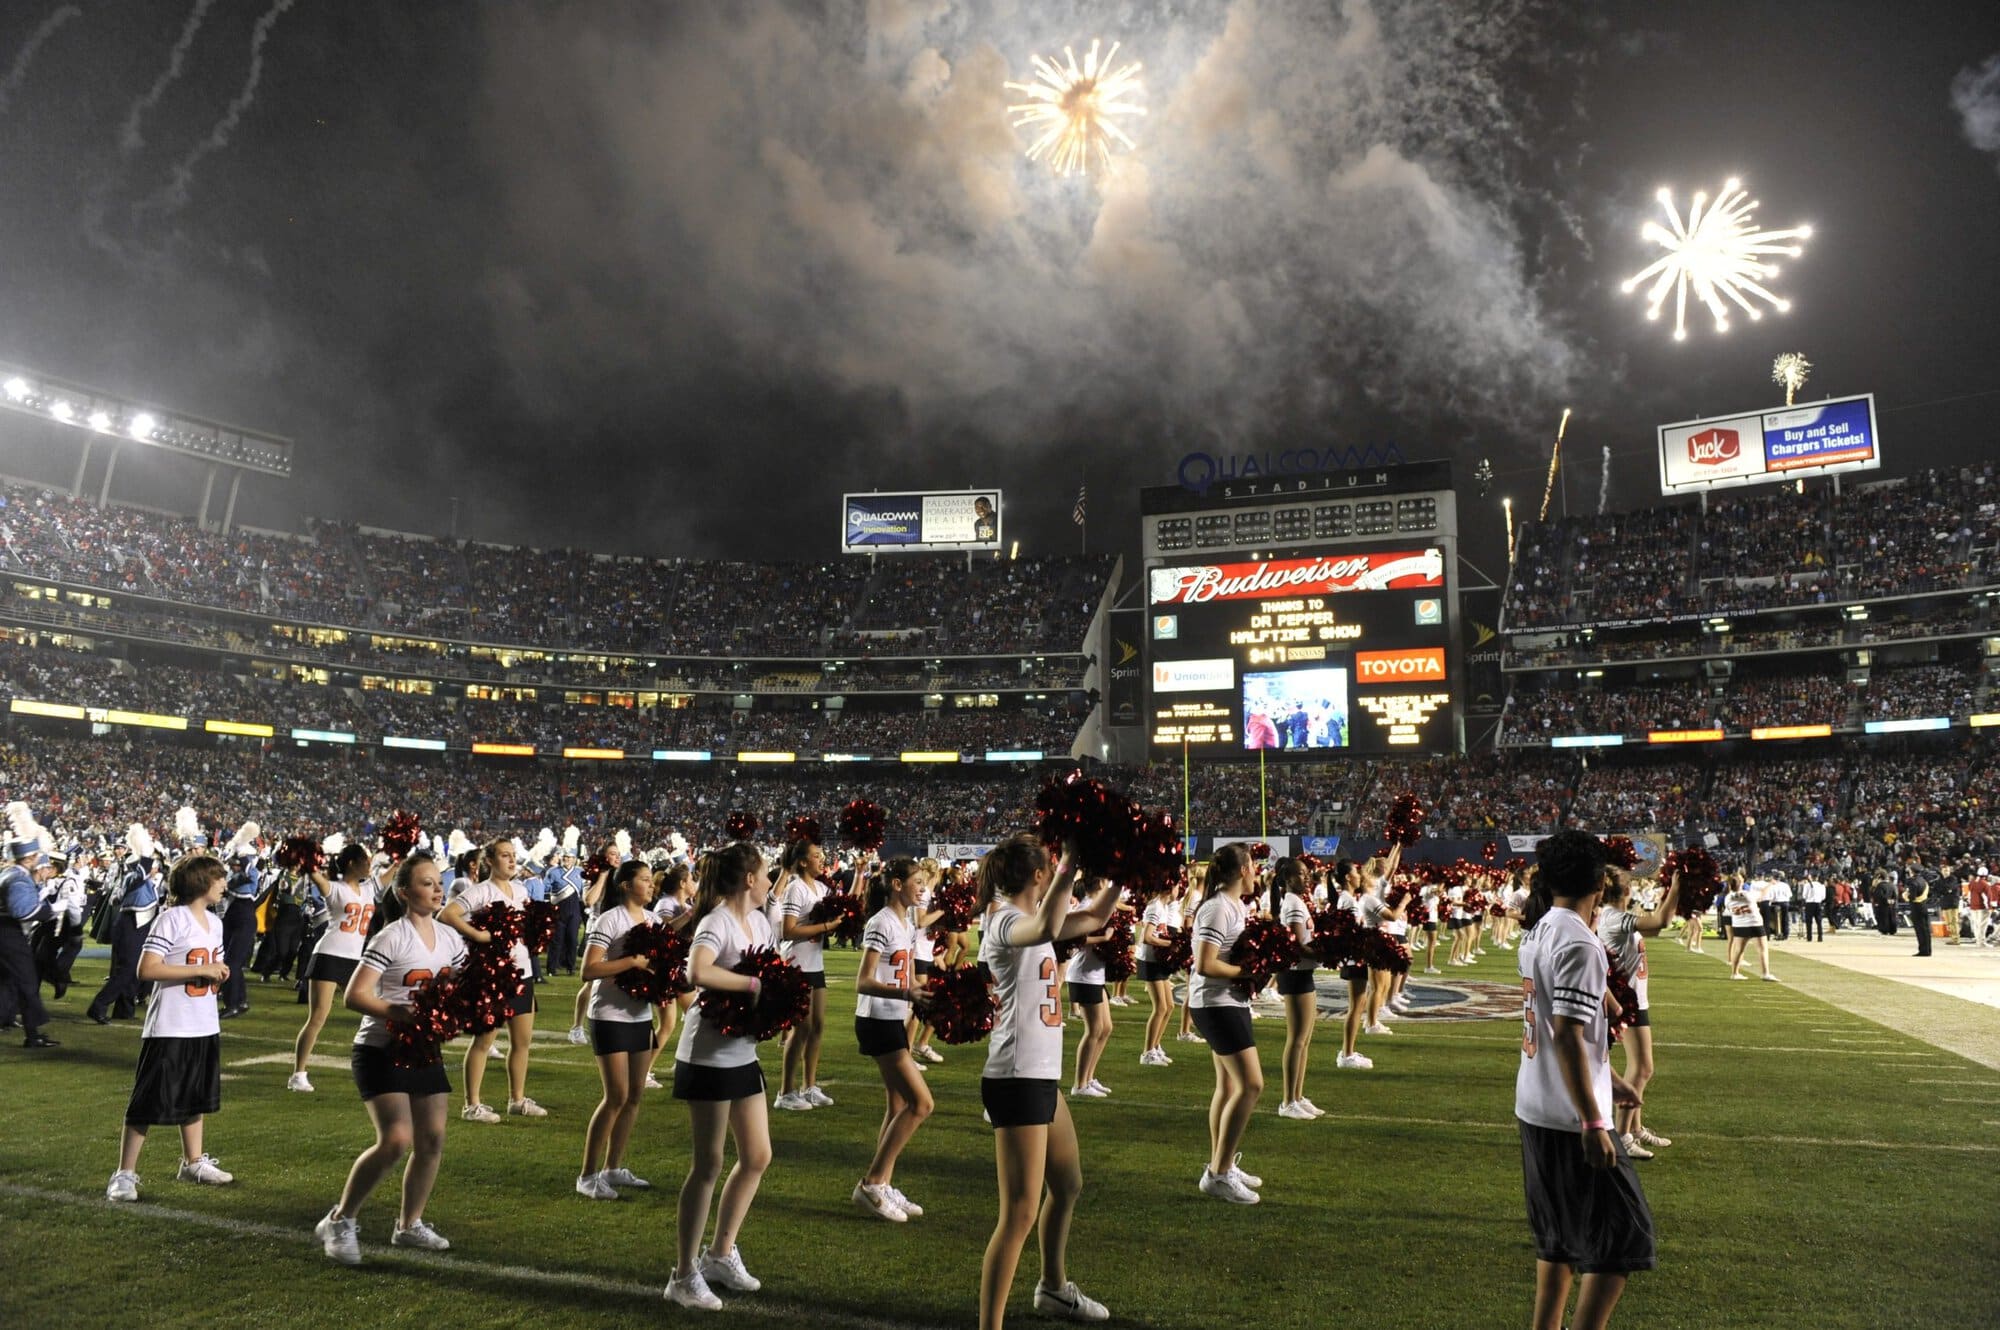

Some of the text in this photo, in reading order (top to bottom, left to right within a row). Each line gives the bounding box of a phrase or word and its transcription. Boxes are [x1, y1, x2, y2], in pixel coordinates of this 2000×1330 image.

[1784, 423, 1849, 441] Buy and Sell
[1690, 431, 1738, 462] Jack
[1771, 433, 1865, 454] Chargers Tickets!
[1224, 473, 1388, 497] STADIUM
[850, 511, 919, 527] QUALCOMM
[1177, 556, 1369, 603] Budweiser
[1261, 599, 1324, 613] THANKS TO
[1251, 611, 1334, 628] DR PEPPER
[1230, 625, 1361, 644] HALFTIME SHOW
[1111, 667, 1139, 680] Sprint
[1360, 657, 1441, 675] TOYOTA
[1040, 957, 1062, 1027] 3
